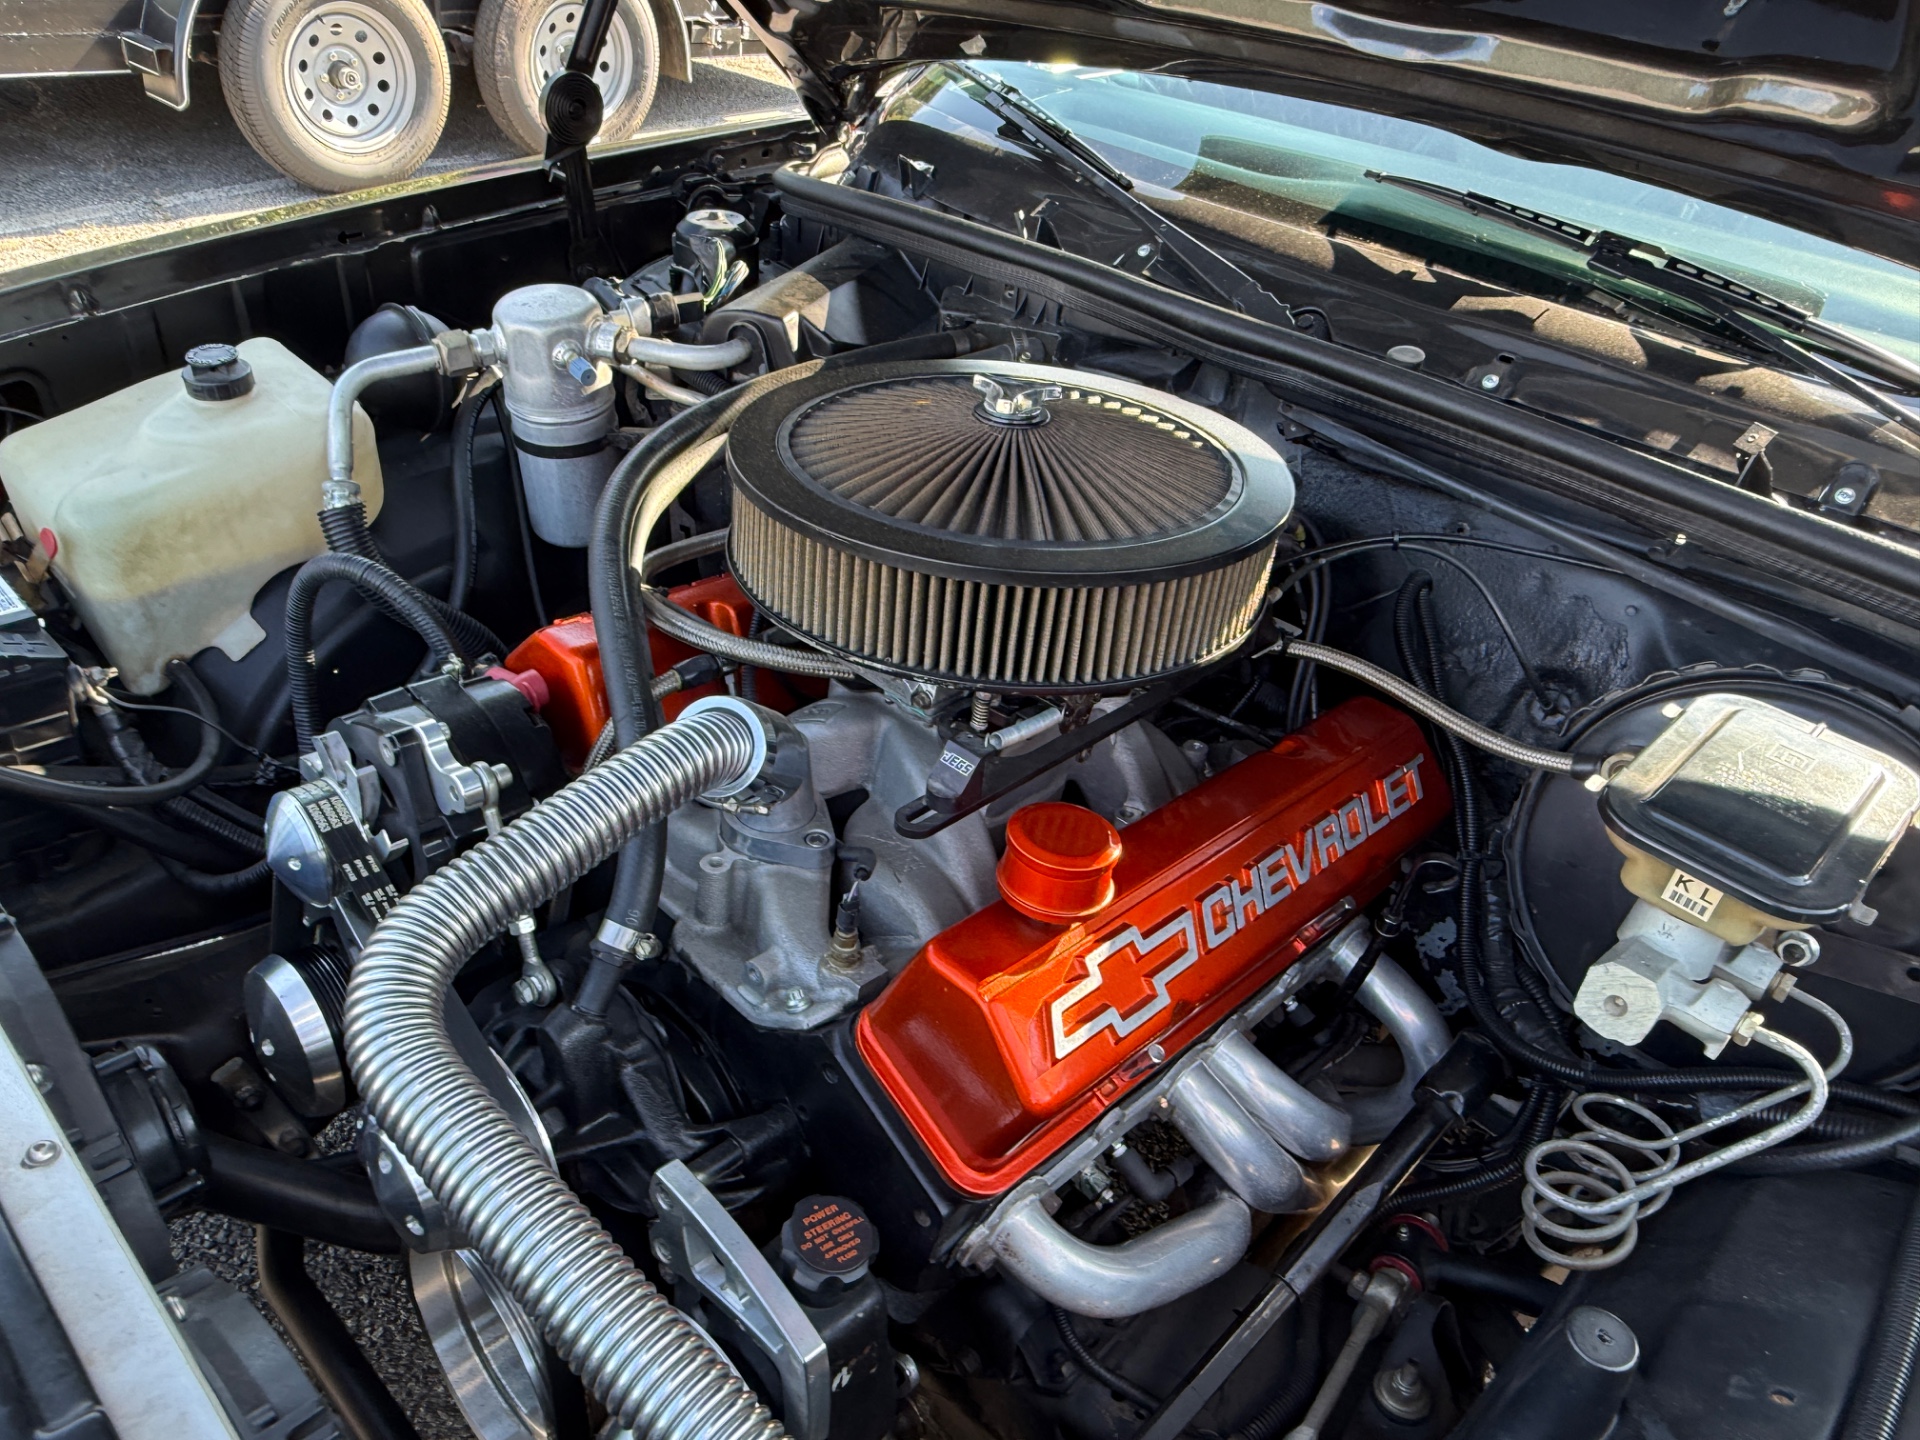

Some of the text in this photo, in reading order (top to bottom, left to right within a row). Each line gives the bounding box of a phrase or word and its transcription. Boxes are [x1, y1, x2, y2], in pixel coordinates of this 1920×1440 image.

[941, 751, 974, 775] JEGS
[1201, 753, 1423, 949] CHEVROLET
[803, 1205, 838, 1225] POWER
[804, 1212, 851, 1238] STEERING
[801, 1242, 812, 1250] DO
[814, 1233, 828, 1244] NOT
